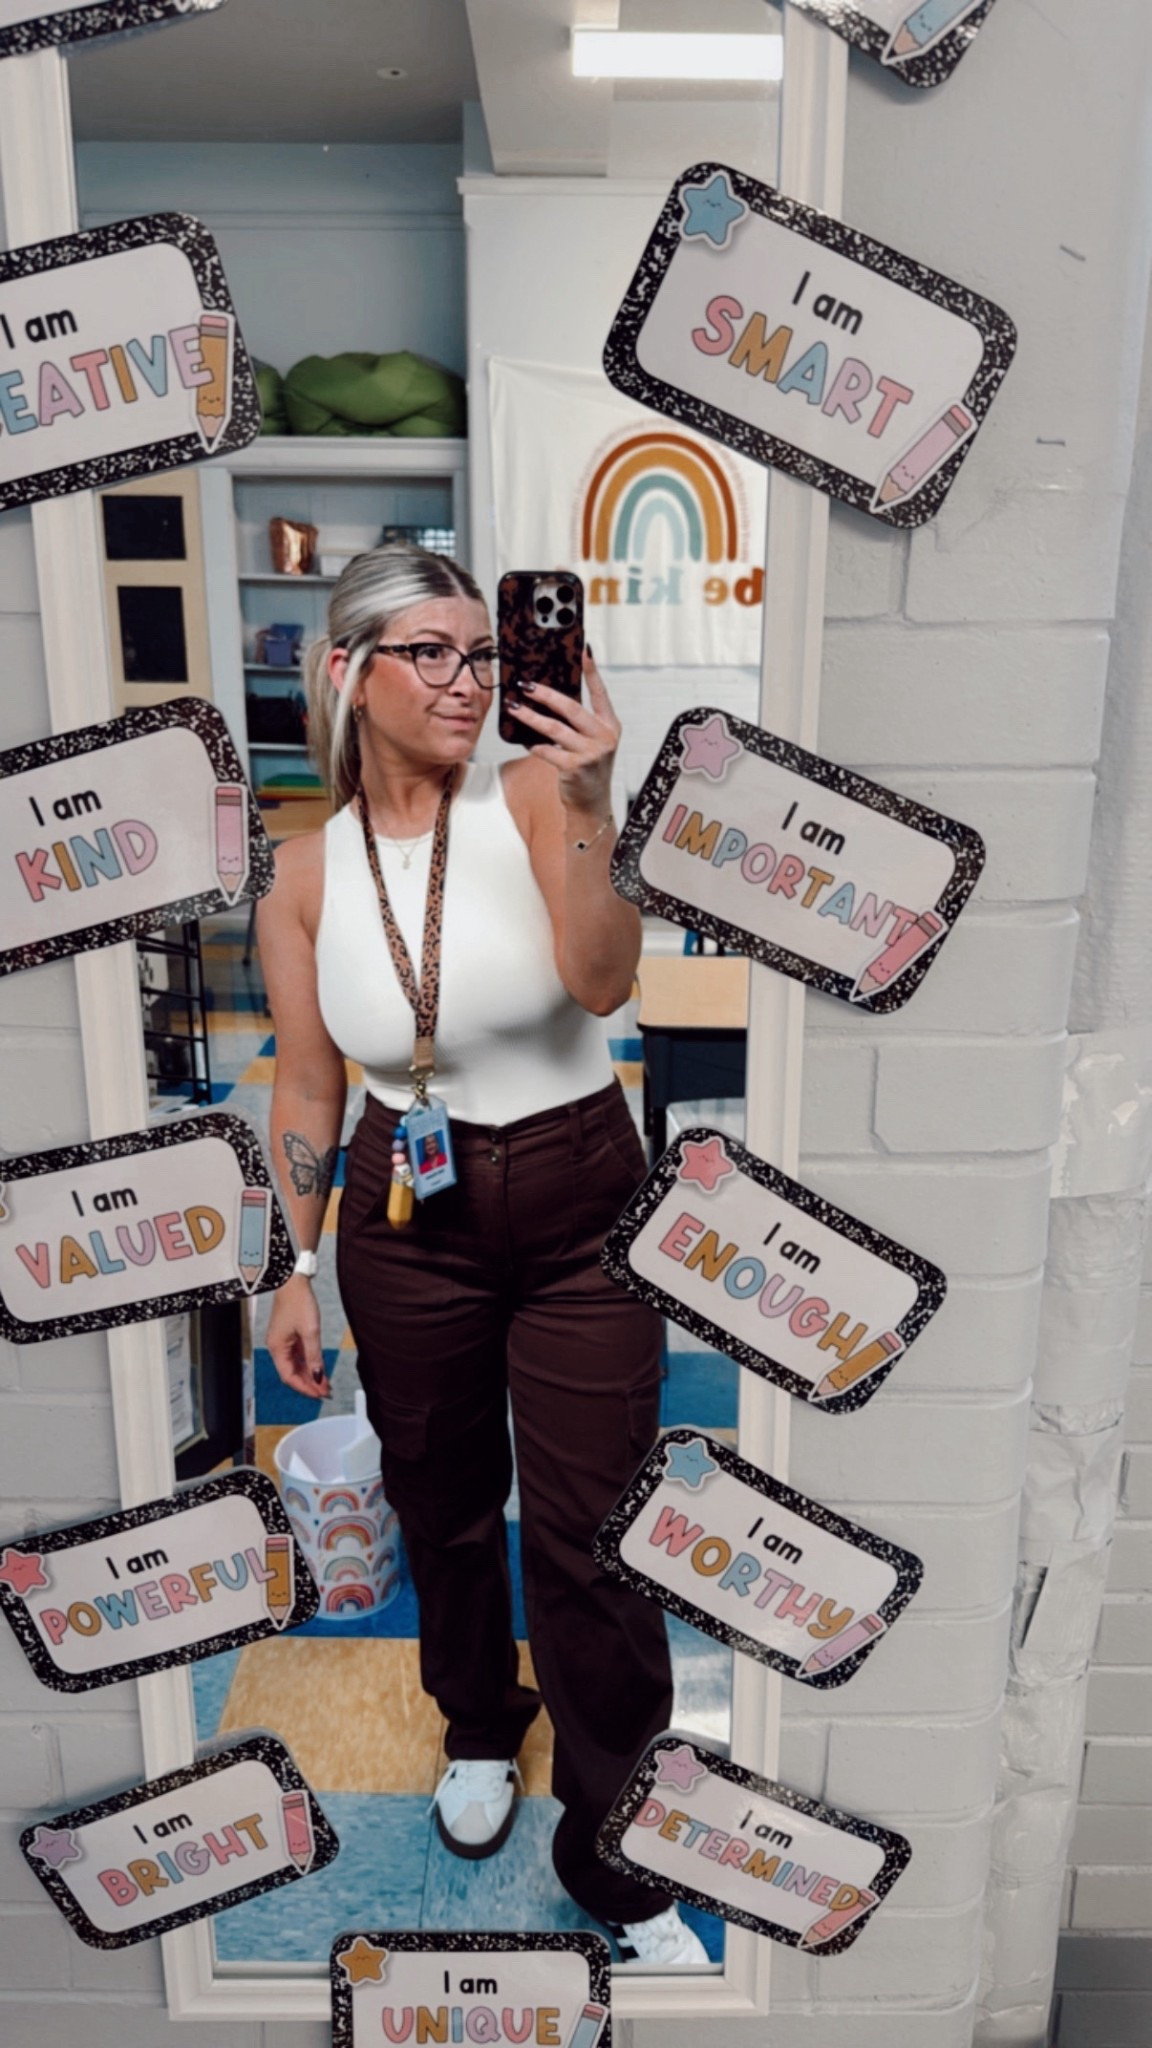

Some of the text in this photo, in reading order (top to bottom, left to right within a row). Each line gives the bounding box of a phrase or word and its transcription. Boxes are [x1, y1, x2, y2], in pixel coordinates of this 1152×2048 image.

[0, 309, 78, 349] I am
[792, 270, 863, 335] I am
[0, 324, 215, 437] EATIVE
[692, 295, 914, 438] SMART
[29, 790, 102, 826] I am
[781, 801, 845, 855] I am
[15, 819, 158, 903] KIND
[662, 804, 918, 946] IMPORTANT
[71, 1187, 138, 1217] I am
[15, 1205, 225, 1289] VALUED
[763, 1222, 821, 1274] I am
[658, 1212, 868, 1360] ENOUGH
[105, 1549, 169, 1579] I am
[747, 1517, 803, 1564] I am
[39, 1547, 278, 1645] POWERFUL
[649, 1505, 855, 1639] WORTHY
[133, 1813, 193, 1844] I am
[633, 1799, 862, 1910] DETERMINED
[739, 1810, 793, 1849] I am
[97, 1813, 268, 1907] BRIGHT
[444, 1971, 498, 1994] I am
[382, 2006, 561, 2045] UNIQUE
